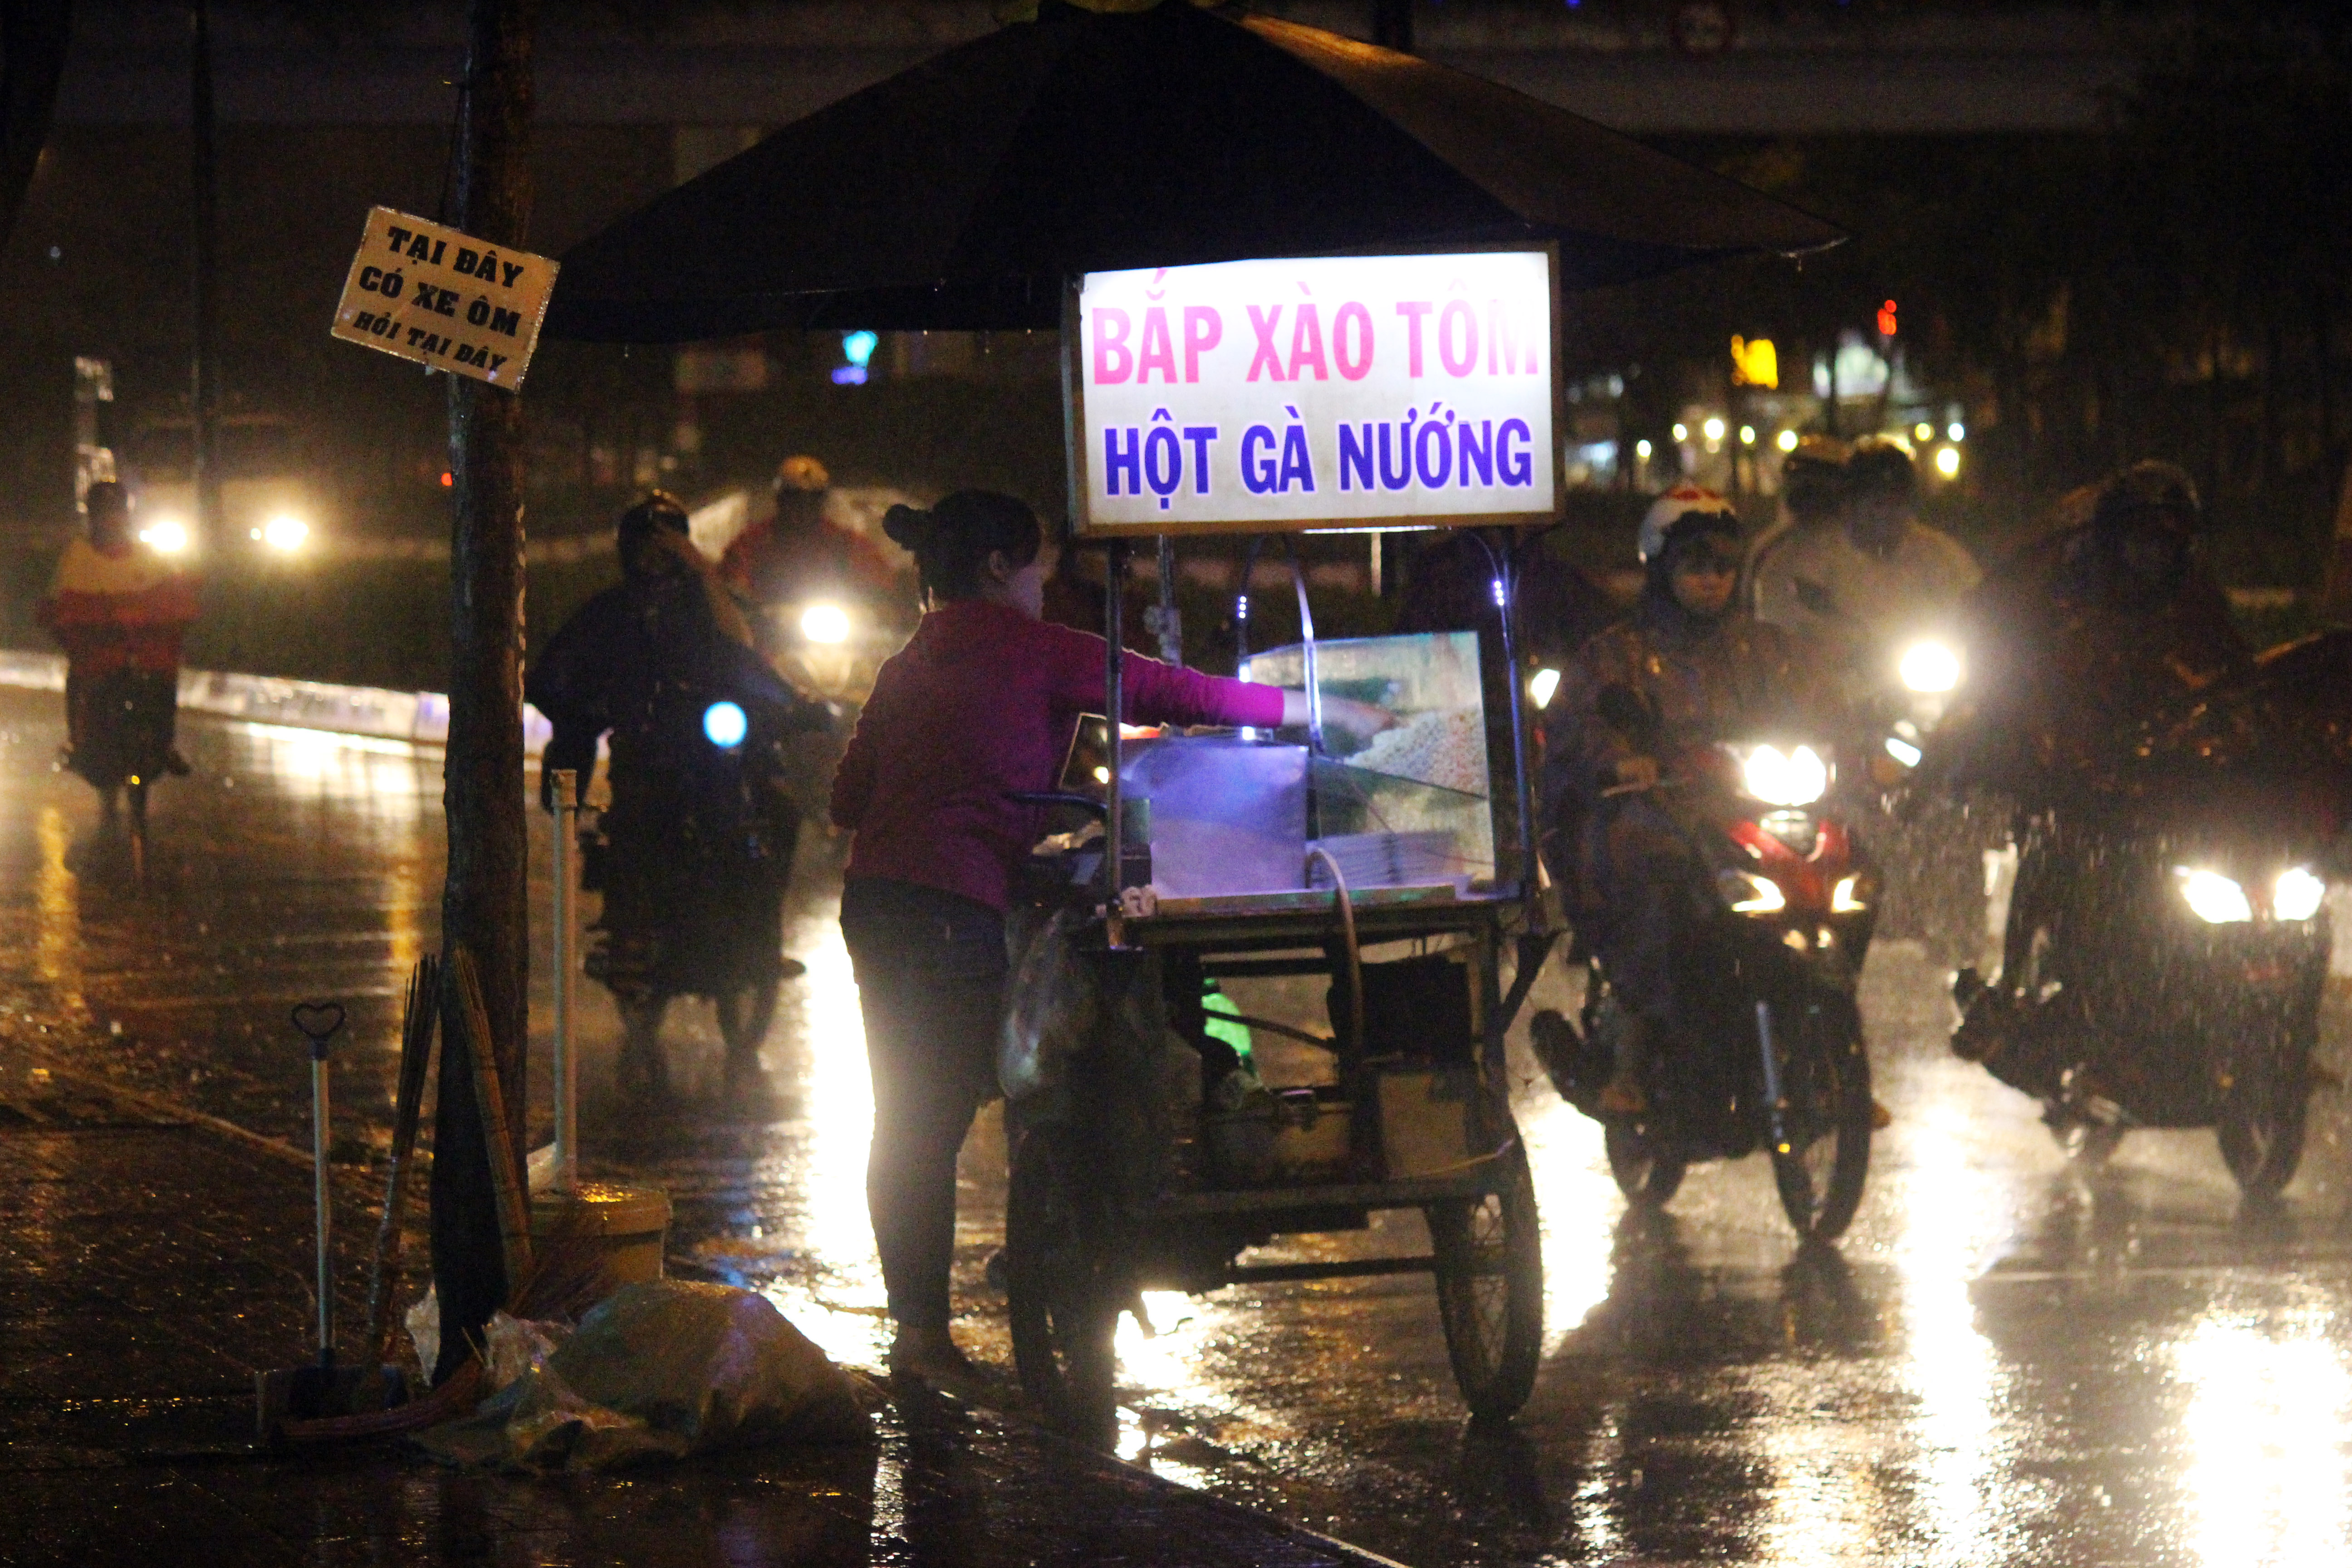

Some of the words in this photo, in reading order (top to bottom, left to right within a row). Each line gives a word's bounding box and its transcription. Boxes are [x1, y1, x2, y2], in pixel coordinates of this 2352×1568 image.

[358, 266, 404, 299] CÓ
[411, 281, 461, 317] XE
[466, 295, 522, 337] ÔM
[388, 226, 447, 265] TẠI
[453, 247, 524, 288] ĐÂY
[1092, 267, 1223, 385] BẮP
[1245, 281, 1375, 382] XÀO
[1396, 278, 1539, 379] TÔM
[1103, 407, 1218, 510] HỘT
[1240, 406, 1316, 493] GÀ
[1338, 401, 1533, 492] NƯỚNG
